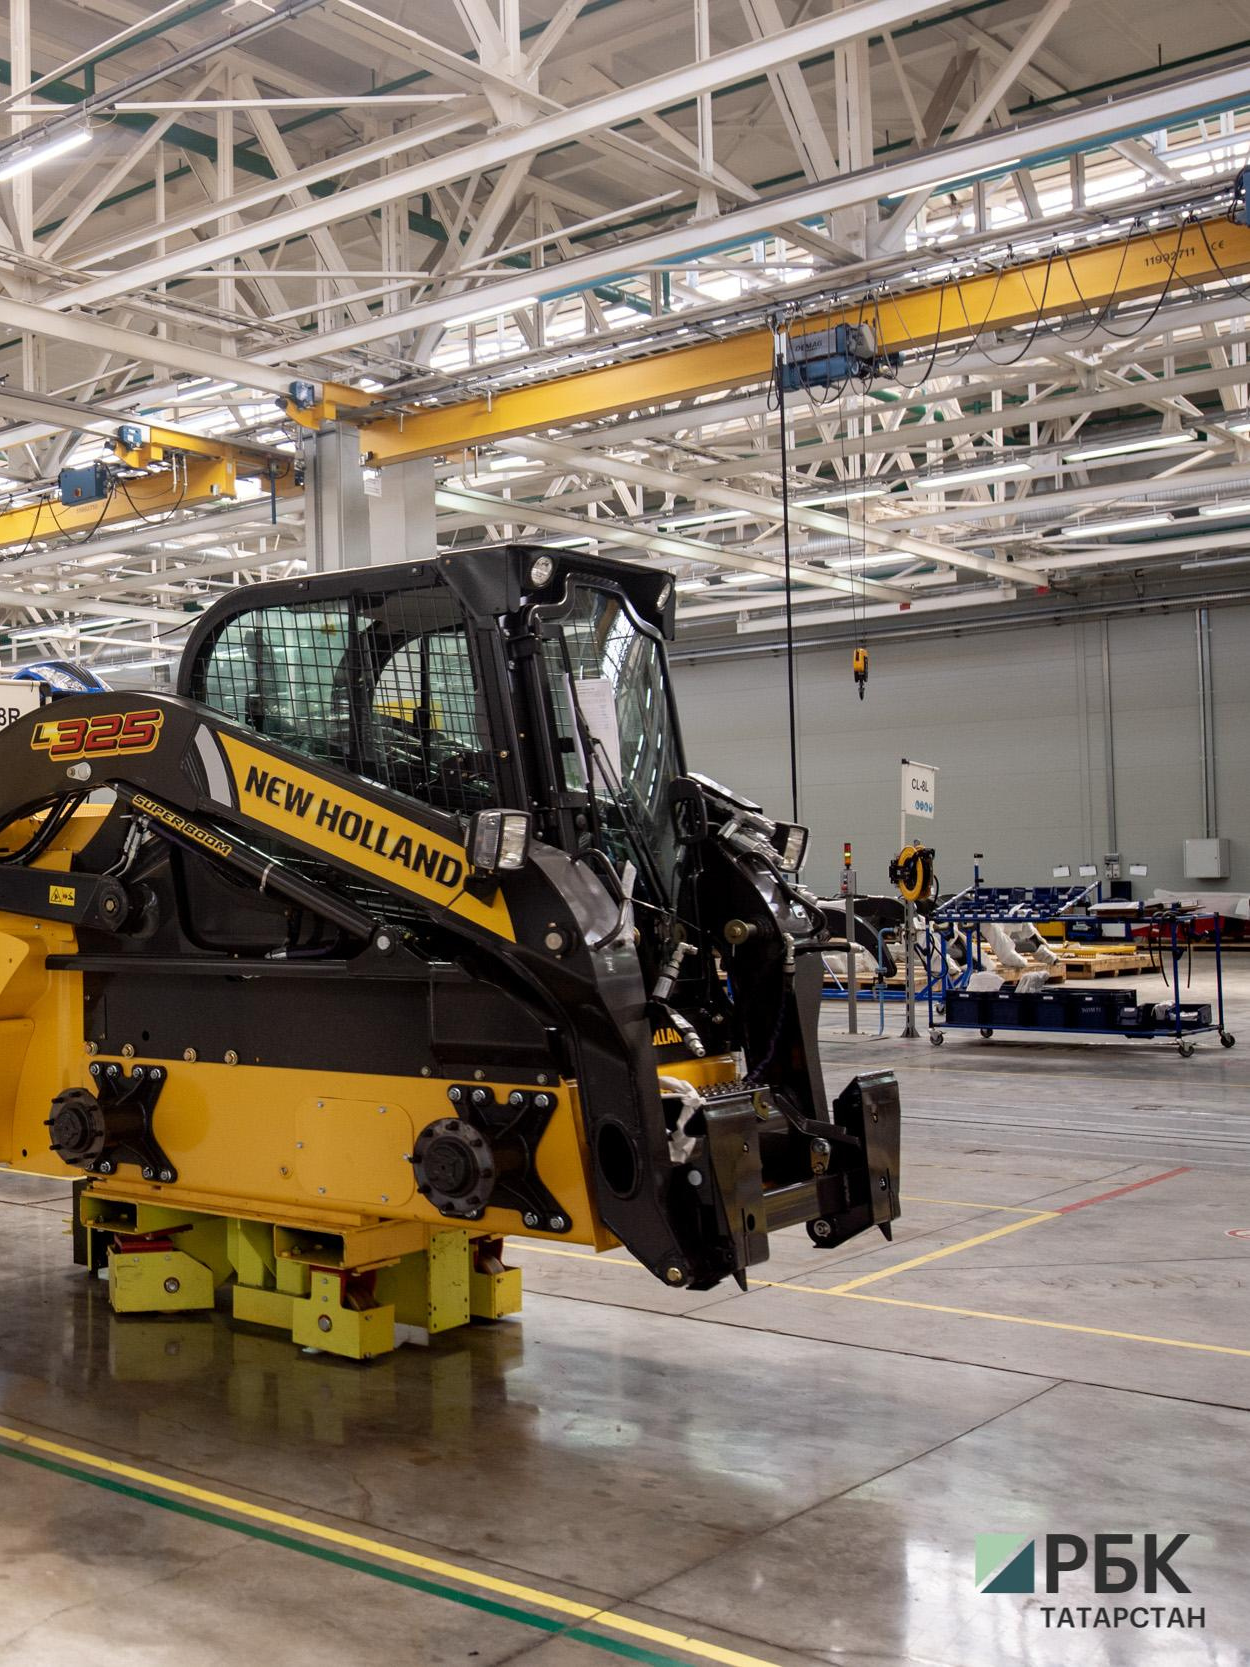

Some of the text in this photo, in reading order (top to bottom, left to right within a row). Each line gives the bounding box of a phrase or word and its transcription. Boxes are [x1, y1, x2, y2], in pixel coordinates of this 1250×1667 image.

[795, 340, 823, 352] DEMAG
[31, 709, 165, 762] L325
[911, 778, 929, 792] CL-8L
[244, 765, 464, 888] NEW HOLLAND
